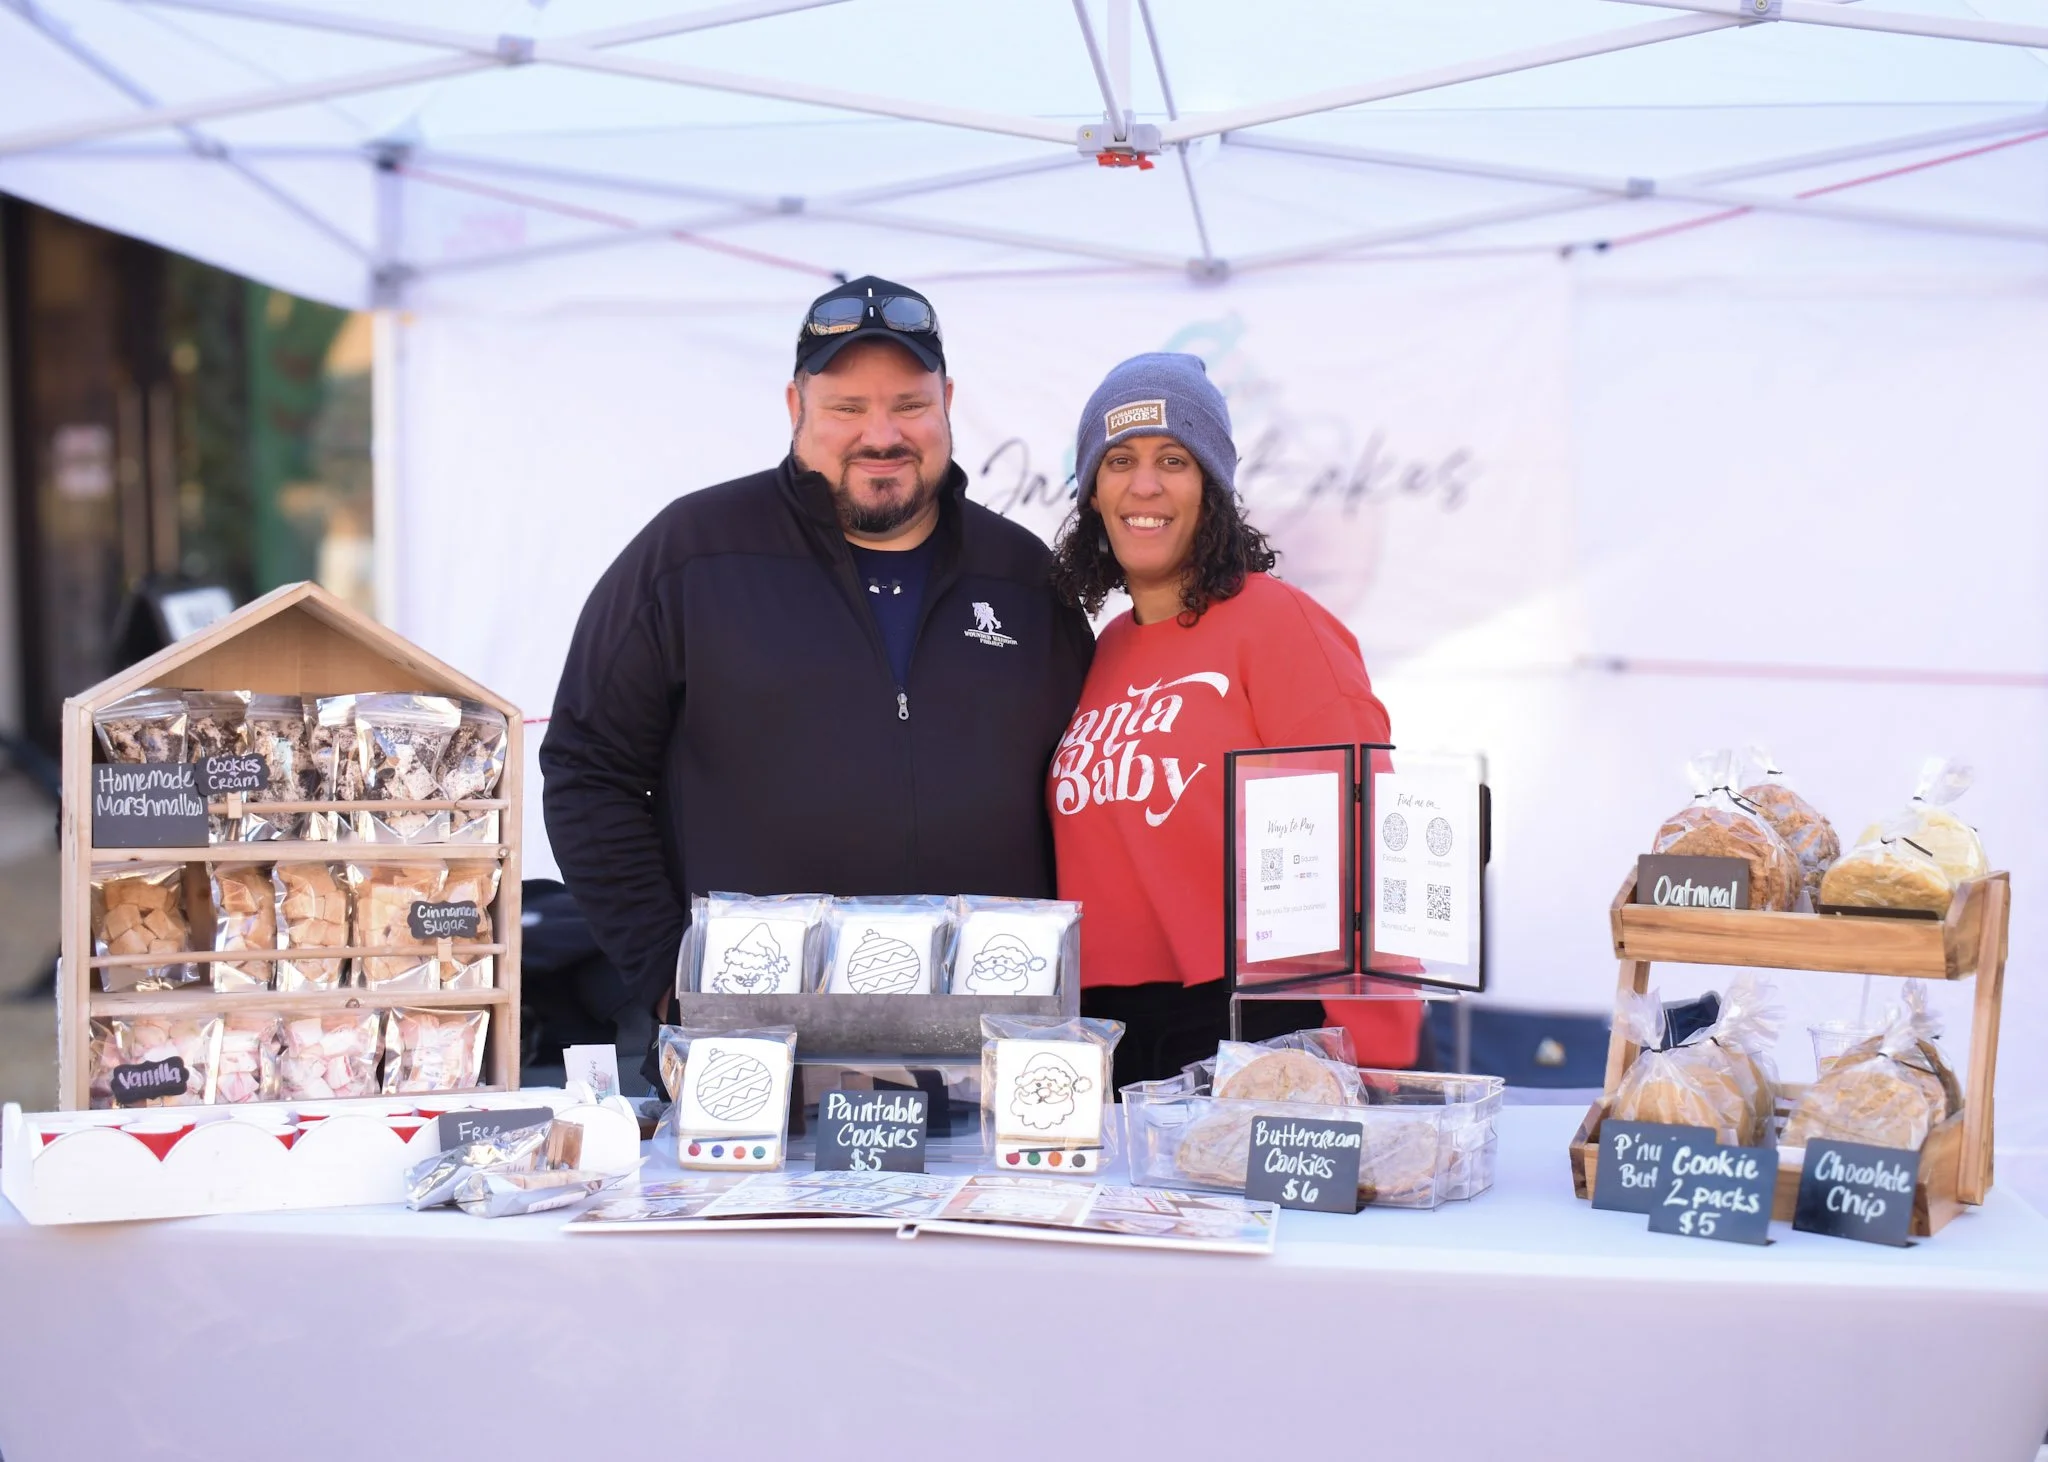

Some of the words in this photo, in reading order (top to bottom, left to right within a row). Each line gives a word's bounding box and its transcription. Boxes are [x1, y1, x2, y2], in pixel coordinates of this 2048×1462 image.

[1111, 412, 1150, 429] LODGE
[1053, 671, 1230, 757] anta
[206, 756, 262, 775] Cookies
[98, 766, 196, 794] Homemade
[208, 775, 260, 790] Cream
[1052, 739, 1207, 827] Baby
[1397, 793, 1413, 807] Find
[1267, 820, 1288, 838] Ways
[1290, 818, 1298, 832] to
[1300, 817, 1315, 836] Pay
[1654, 875, 1738, 910] Oatmeal
[417, 905, 478, 919] Cinnamon
[423, 919, 468, 936] Sugar
[118, 1063, 182, 1090] Vanilla
[827, 1093, 924, 1124] Paintable
[837, 1122, 919, 1149] Cookies
[1255, 1120, 1360, 1149] Buttercream
[849, 1148, 886, 1171] $5
[1264, 1147, 1337, 1179] Cookies
[1672, 1145, 1759, 1180] Cookie
[1814, 1150, 1912, 1193] Chocolate
[1282, 1178, 1319, 1203] $6
[1663, 1178, 1689, 1206] 2
[1692, 1186, 1760, 1214] packs
[1826, 1185, 1887, 1224] Chip
[1679, 1210, 1721, 1236] $5
